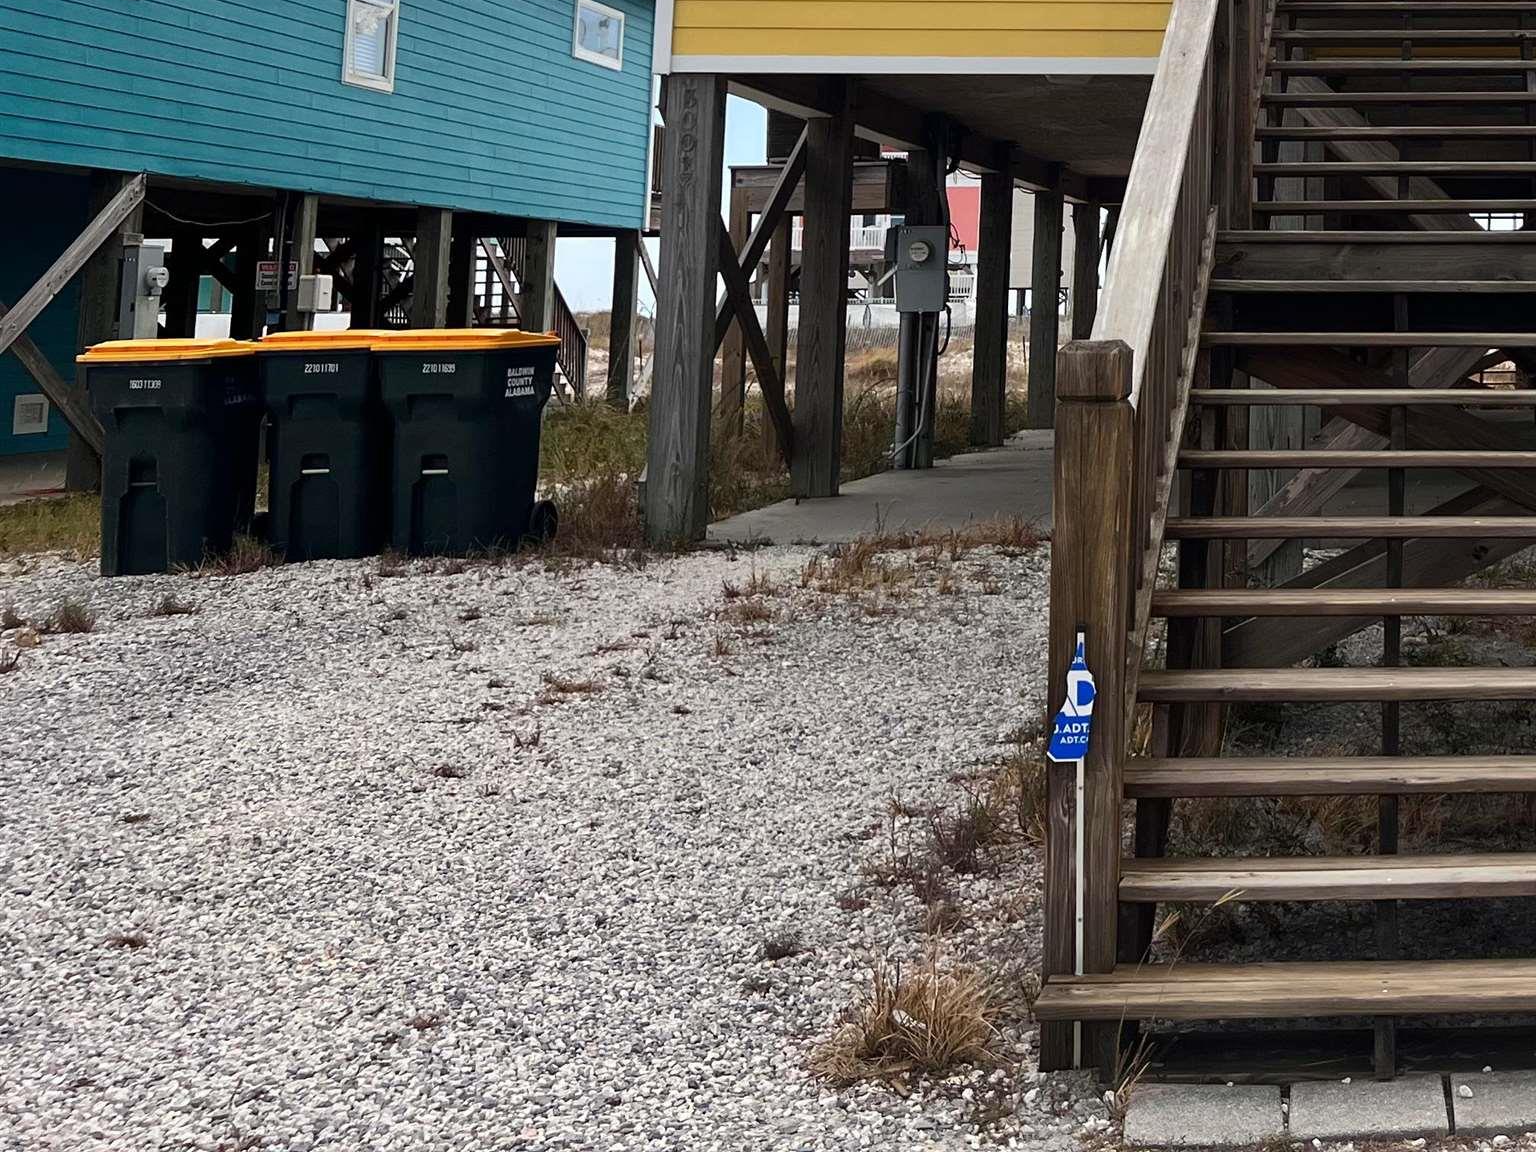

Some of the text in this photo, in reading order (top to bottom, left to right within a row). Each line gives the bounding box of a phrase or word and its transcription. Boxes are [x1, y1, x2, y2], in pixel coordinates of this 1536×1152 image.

[507, 366, 535, 377] BALDWIN
[507, 376, 533, 387] COUNTY
[504, 386, 535, 398] ALABAMA
